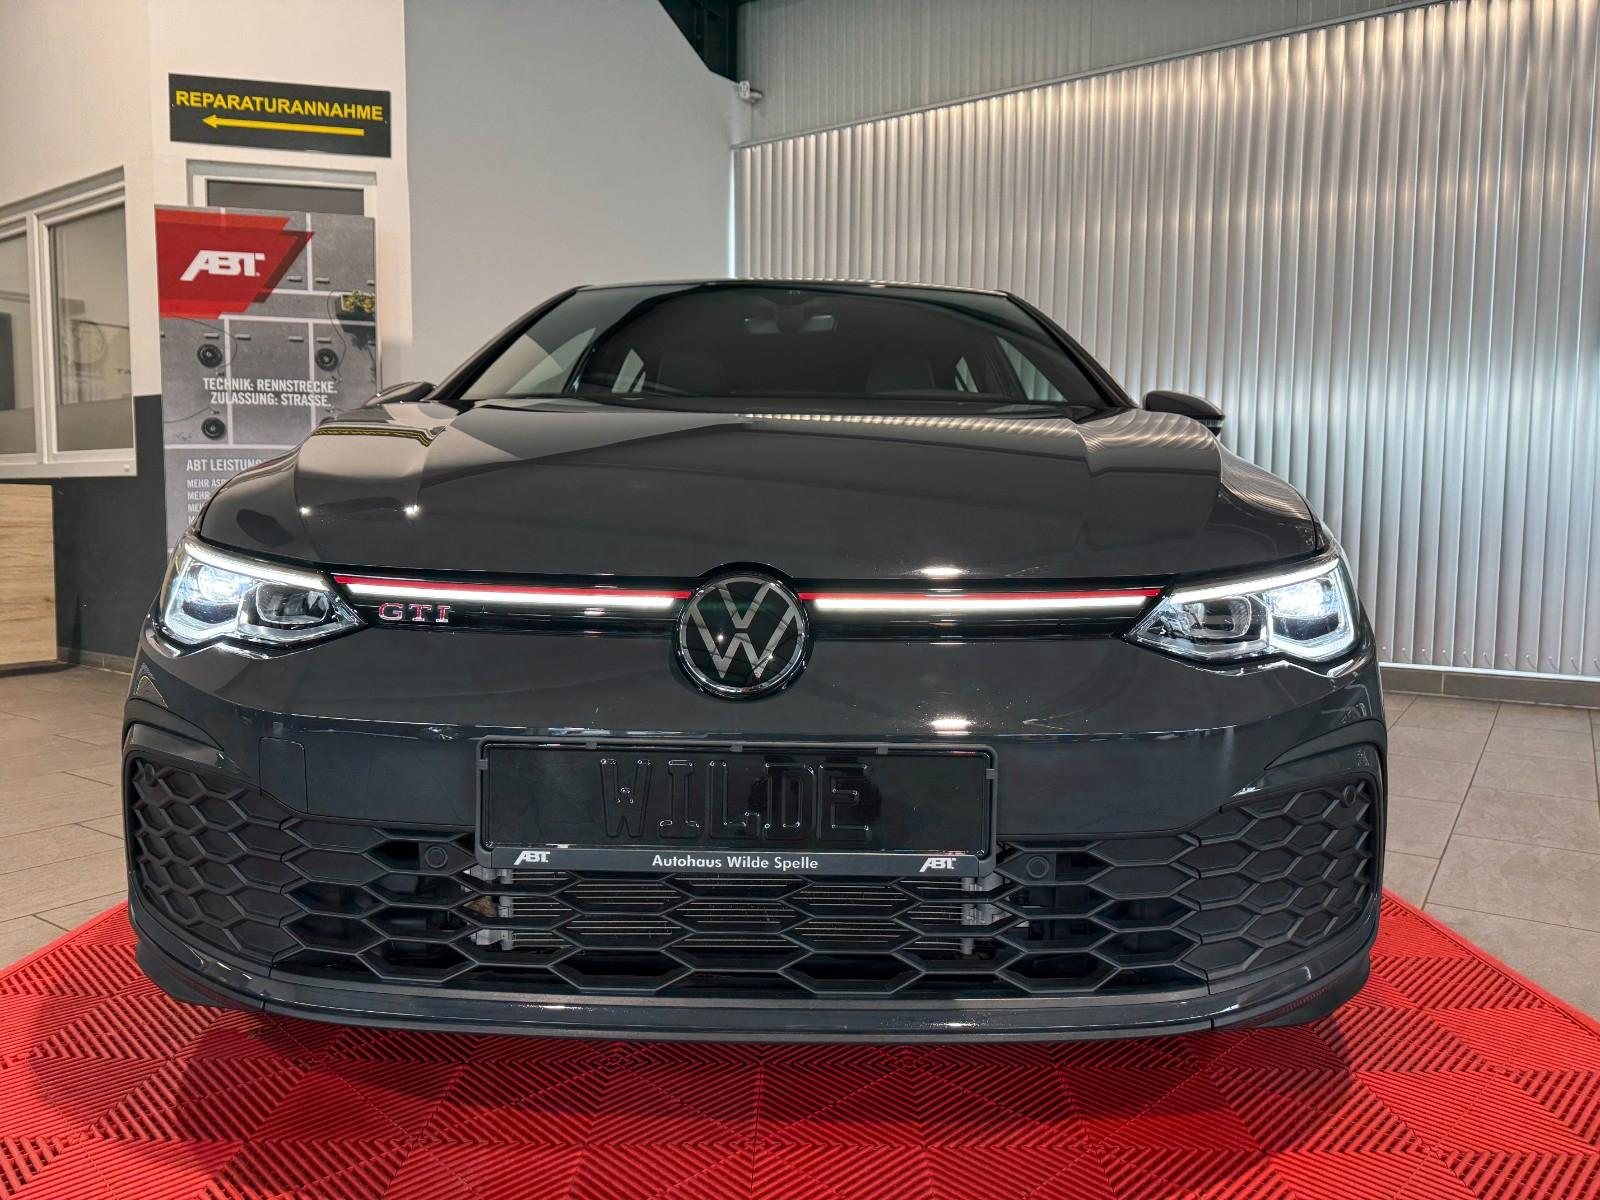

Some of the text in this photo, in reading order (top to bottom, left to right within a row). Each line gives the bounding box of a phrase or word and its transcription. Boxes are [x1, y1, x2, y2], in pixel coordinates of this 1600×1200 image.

[175, 90, 384, 122] REPARATURANNAHME
[179, 249, 266, 281] ABT
[202, 377, 338, 394] TECHNIK: RENNSTRECKE.
[210, 391, 332, 407] ZULASSUNG: STRASSE.
[186, 458, 208, 472] ABT
[186, 478, 210, 489] MEHR
[378, 602, 451, 623] GTI
[600, 758, 872, 841] WILDE
[513, 850, 551, 866] ABT
[651, 854, 819, 872] Autohaus Wilde Spelle
[919, 857, 957, 873] ABT
